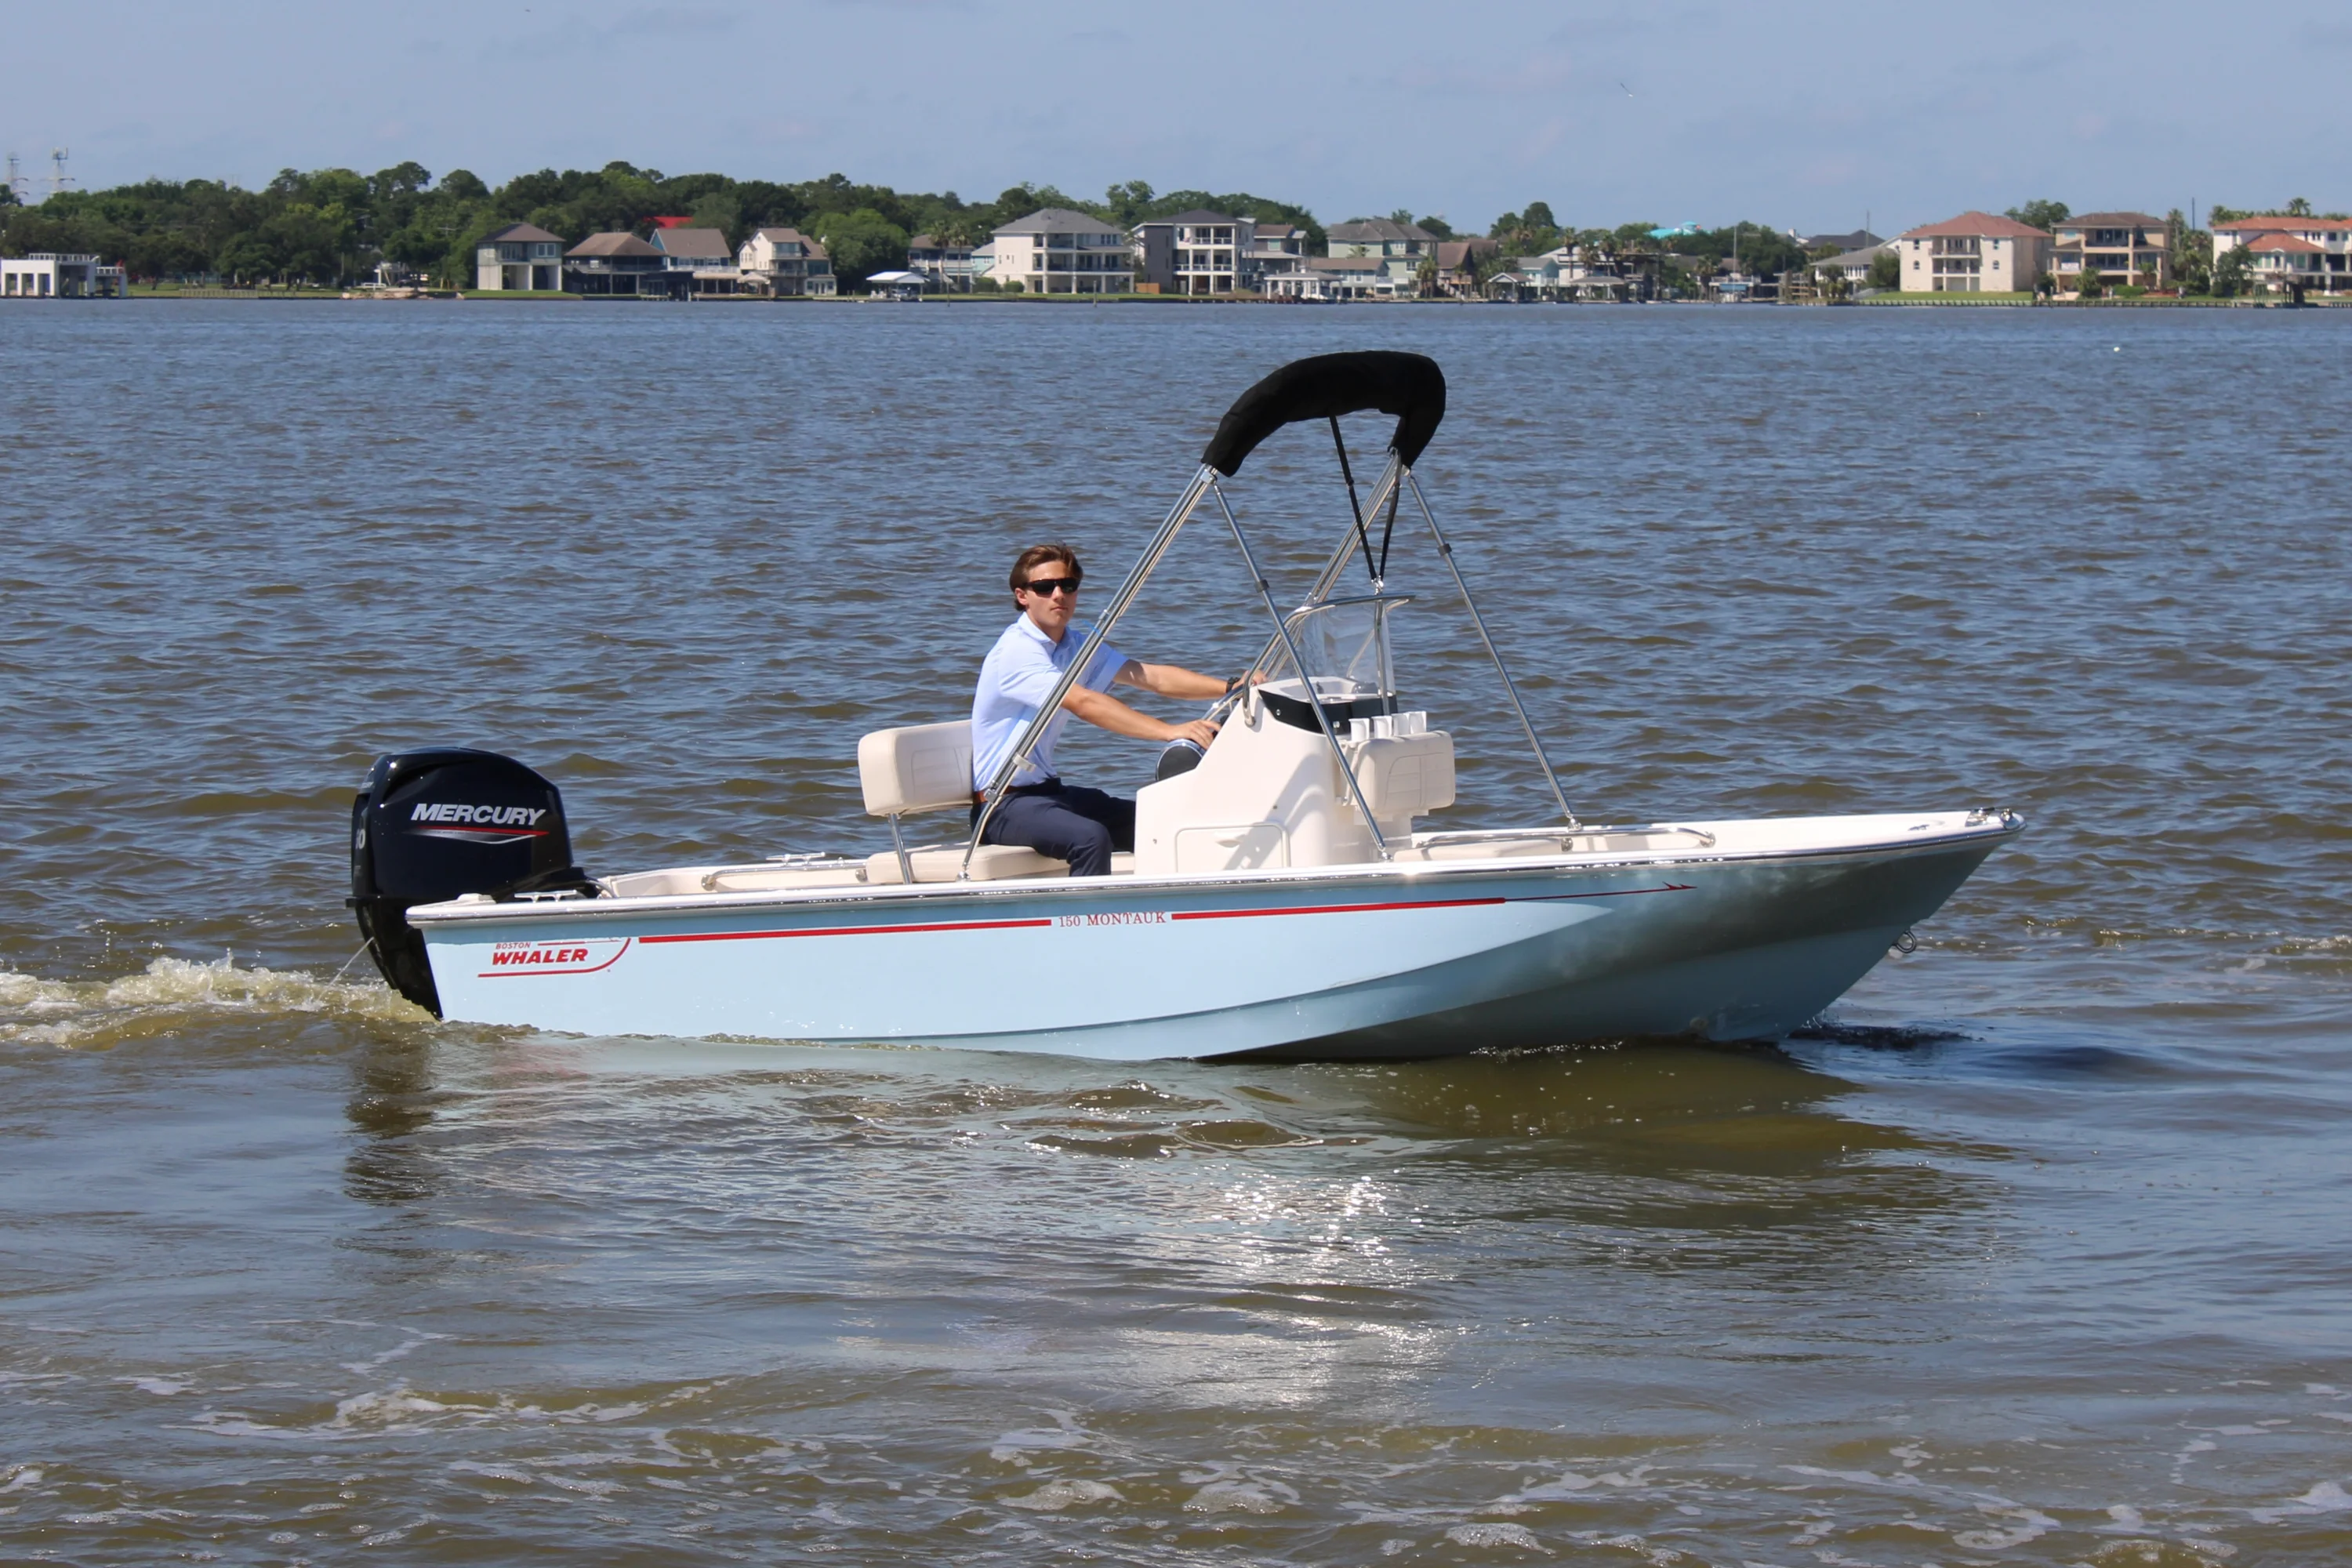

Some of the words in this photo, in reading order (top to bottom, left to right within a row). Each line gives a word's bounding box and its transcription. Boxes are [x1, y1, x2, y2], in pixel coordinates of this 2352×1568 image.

[411, 803, 546, 826] MERCURY
[1059, 915, 1080, 927] 150
[1087, 911, 1167, 926] MONTAUK
[492, 949, 589, 965] WHALER
